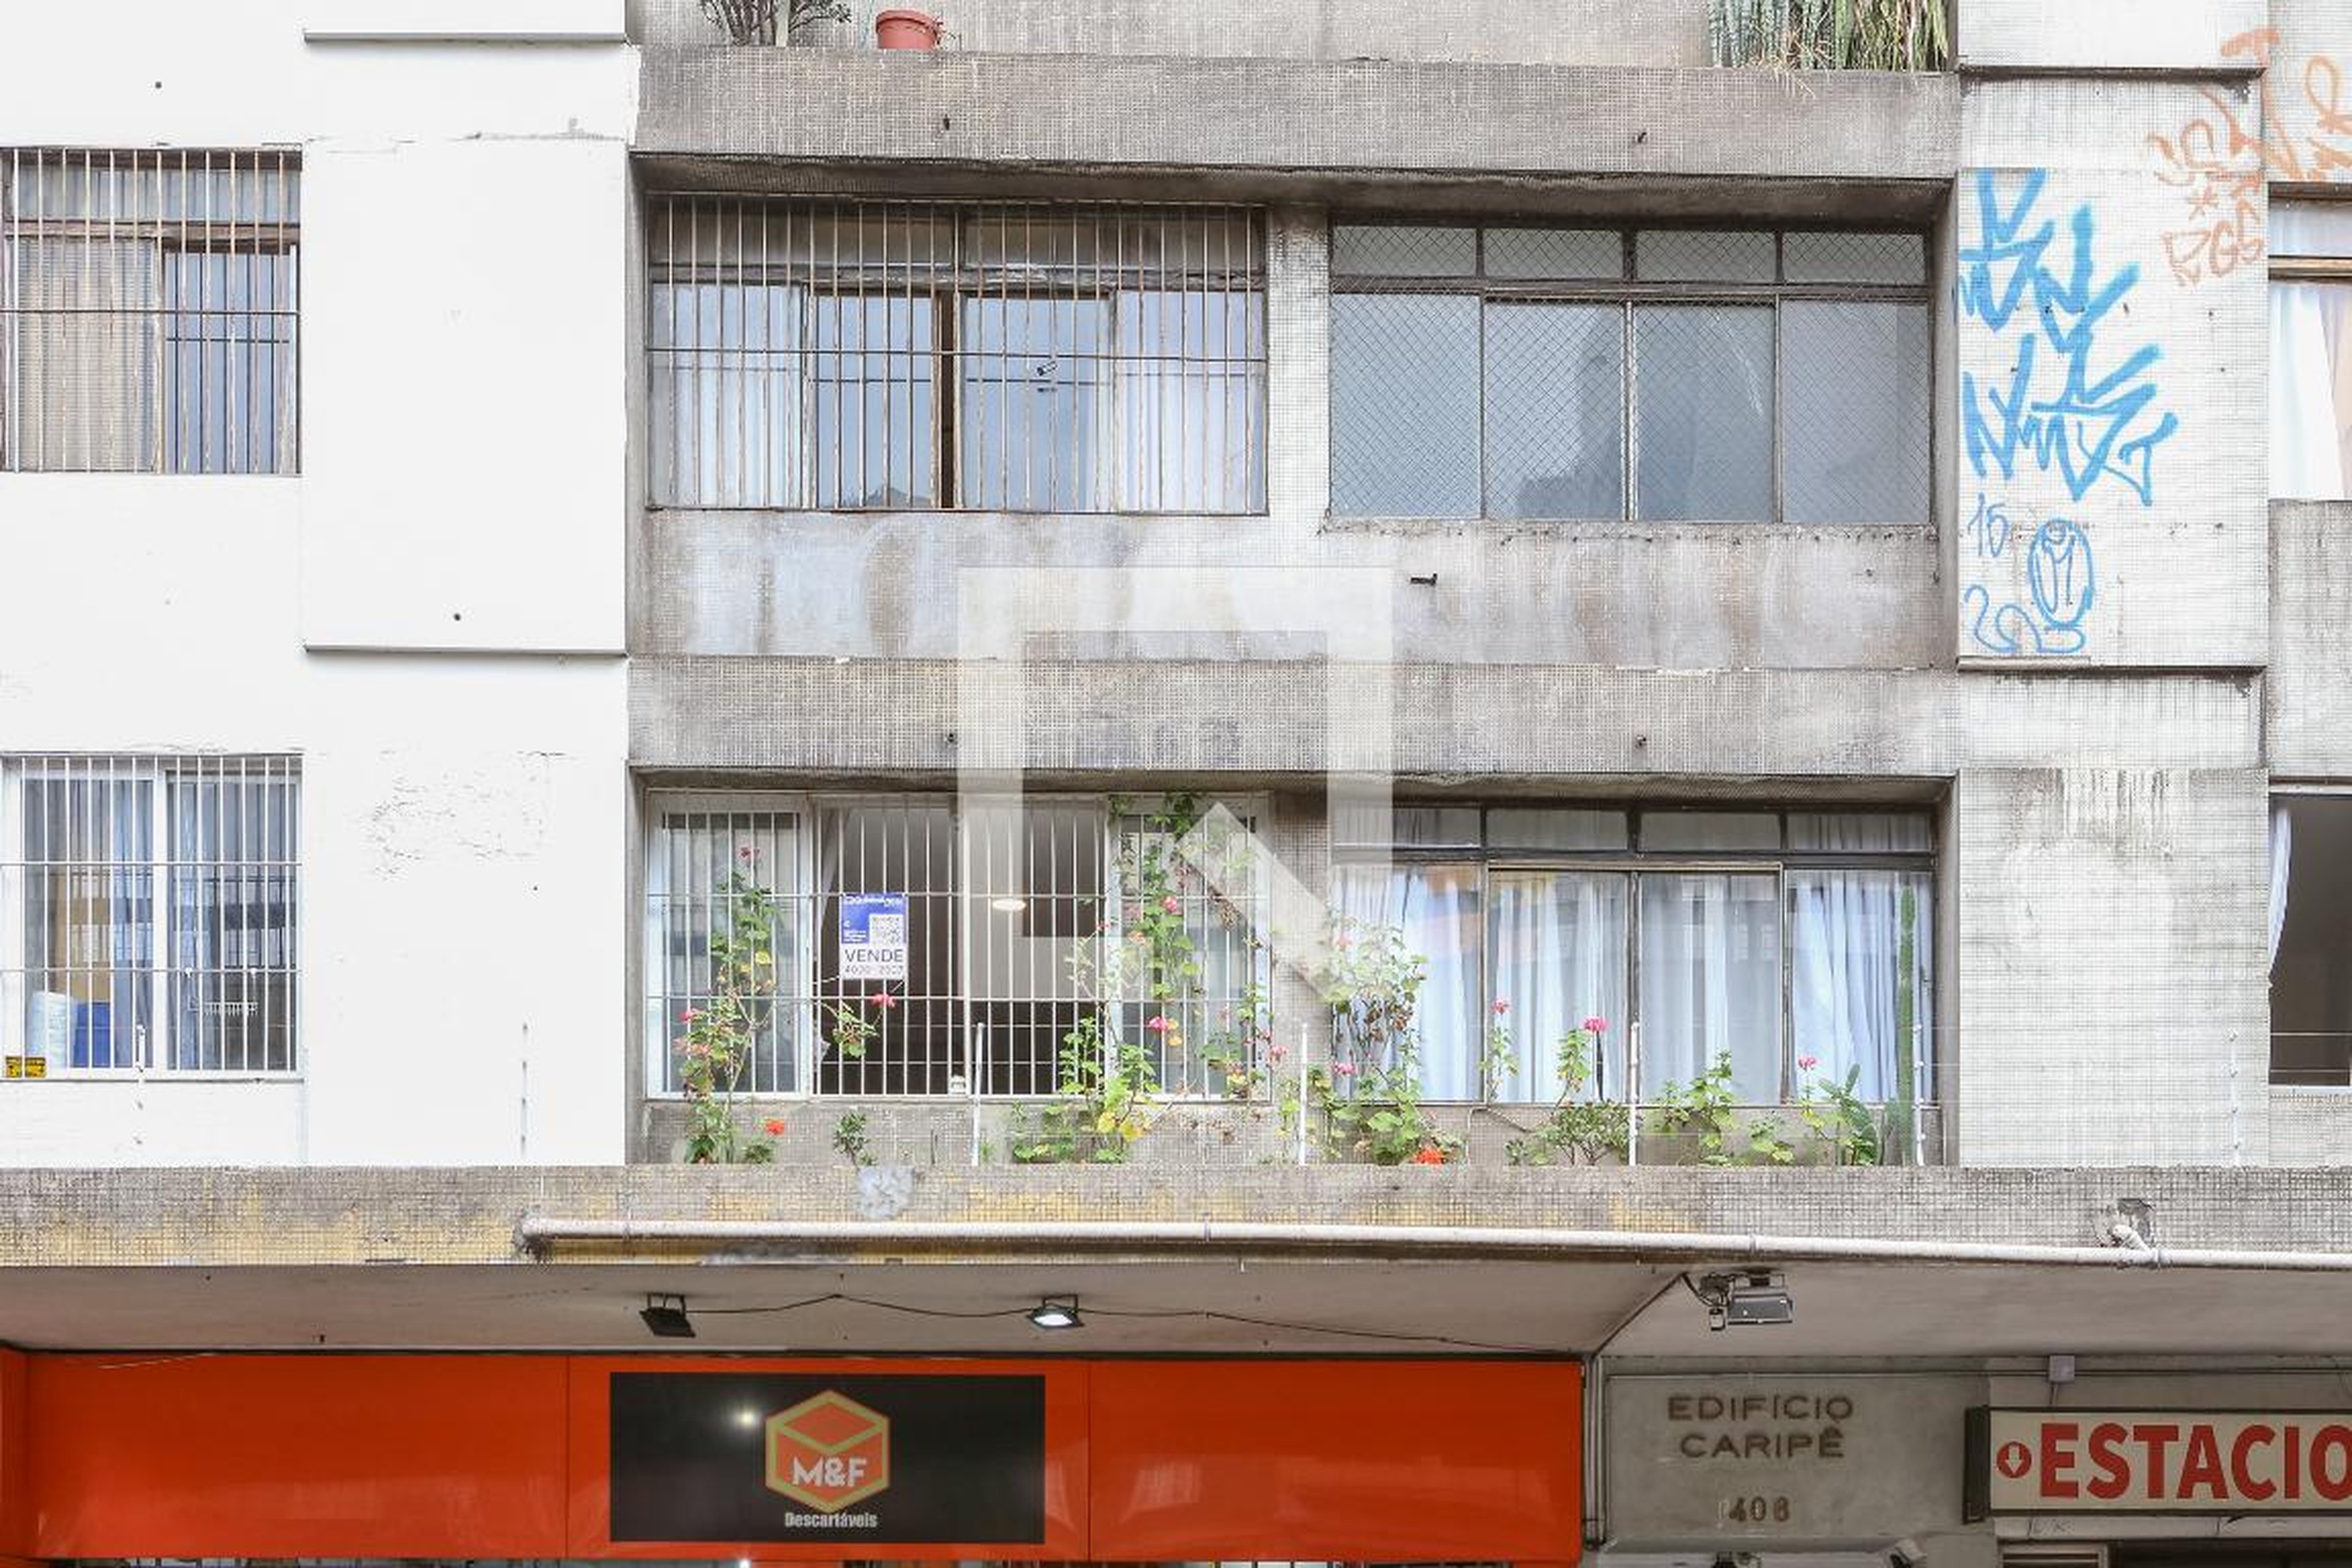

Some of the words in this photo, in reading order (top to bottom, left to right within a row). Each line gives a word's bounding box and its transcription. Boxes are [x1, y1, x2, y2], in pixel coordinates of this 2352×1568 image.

[845, 949, 903, 962] VENDE
[1680, 1426, 1844, 1458] CARIPÊ
[793, 1456, 867, 1487] M&F
[2041, 1423, 2352, 1500] ESTACIO
[785, 1510, 878, 1528] Descartáveis
